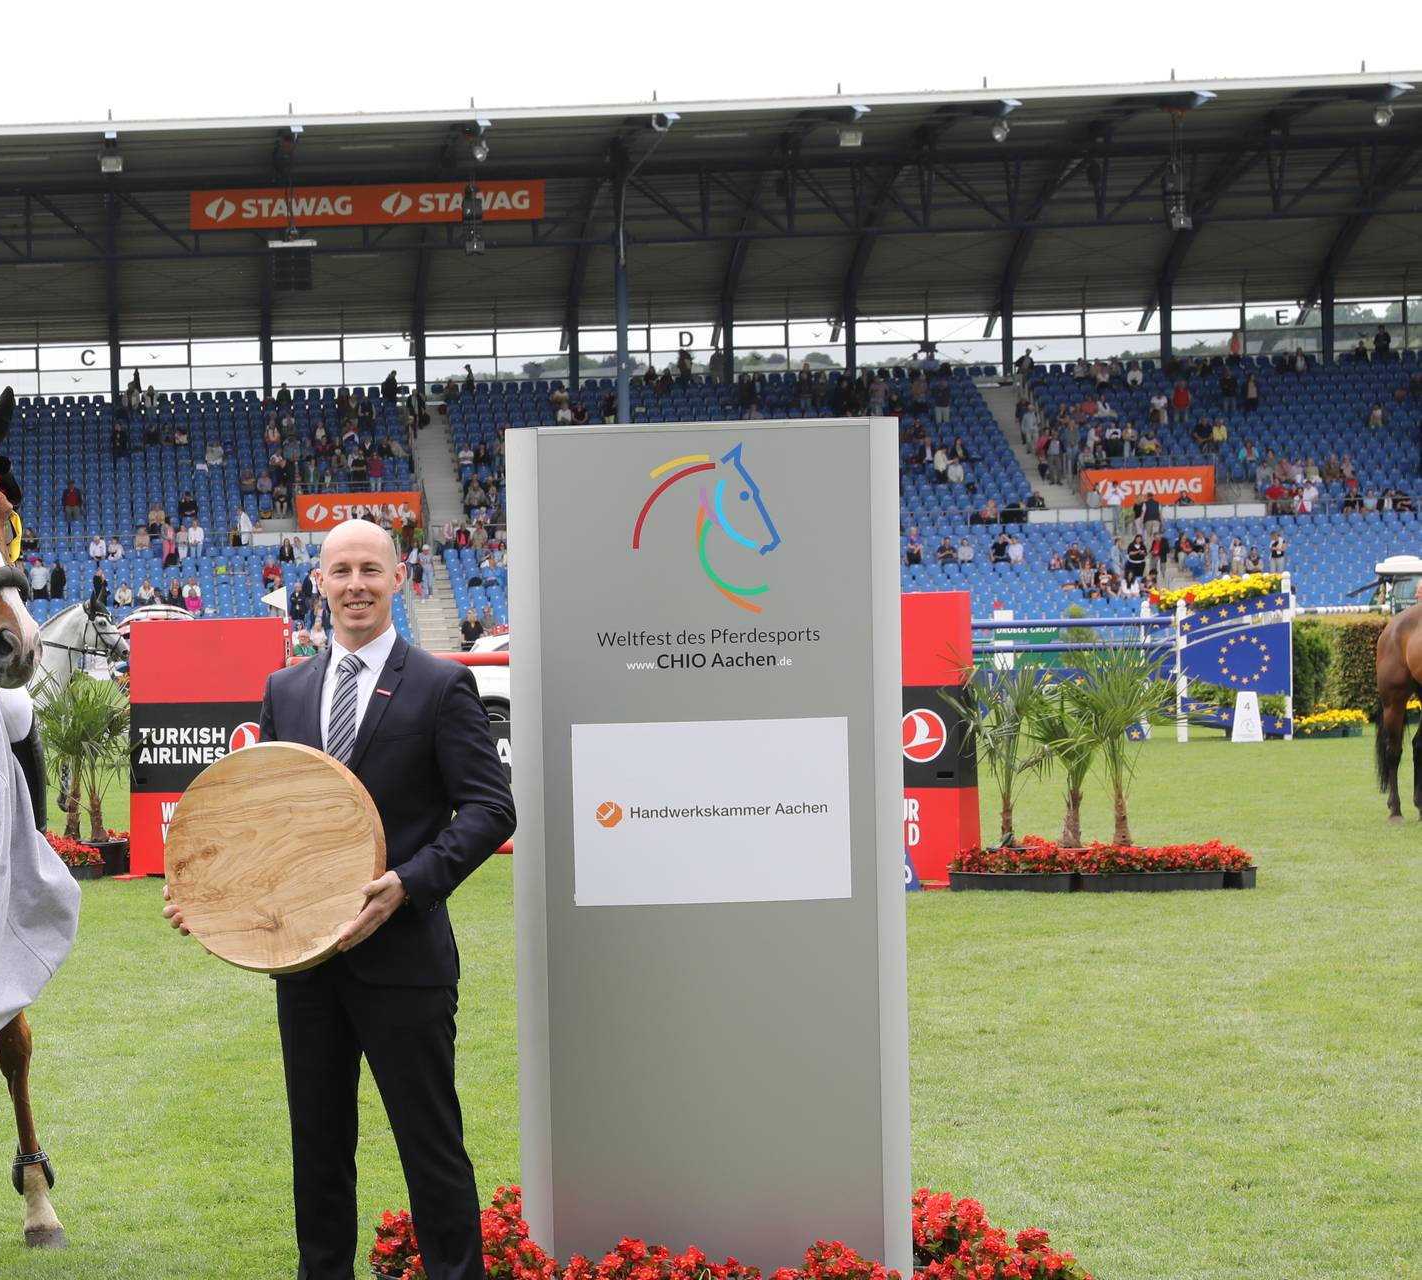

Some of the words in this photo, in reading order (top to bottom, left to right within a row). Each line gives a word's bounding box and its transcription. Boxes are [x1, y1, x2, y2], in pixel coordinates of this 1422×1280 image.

[242, 196, 353, 218] STAWAG
[1275, 310, 1289, 326] E
[679, 331, 693, 347] D
[81, 349, 96, 366] C
[1120, 477, 1203, 496] STAWAG
[597, 630, 672, 647] Weltfest
[676, 629, 706, 645] des
[711, 627, 821, 645] Pferdesports
[1244, 702, 1250, 710] 4
[138, 727, 226, 745] TURKISH
[138, 746, 226, 765] AIRLINES
[630, 804, 772, 819] Handwerkskammer
[774, 801, 828, 815] Aachen
